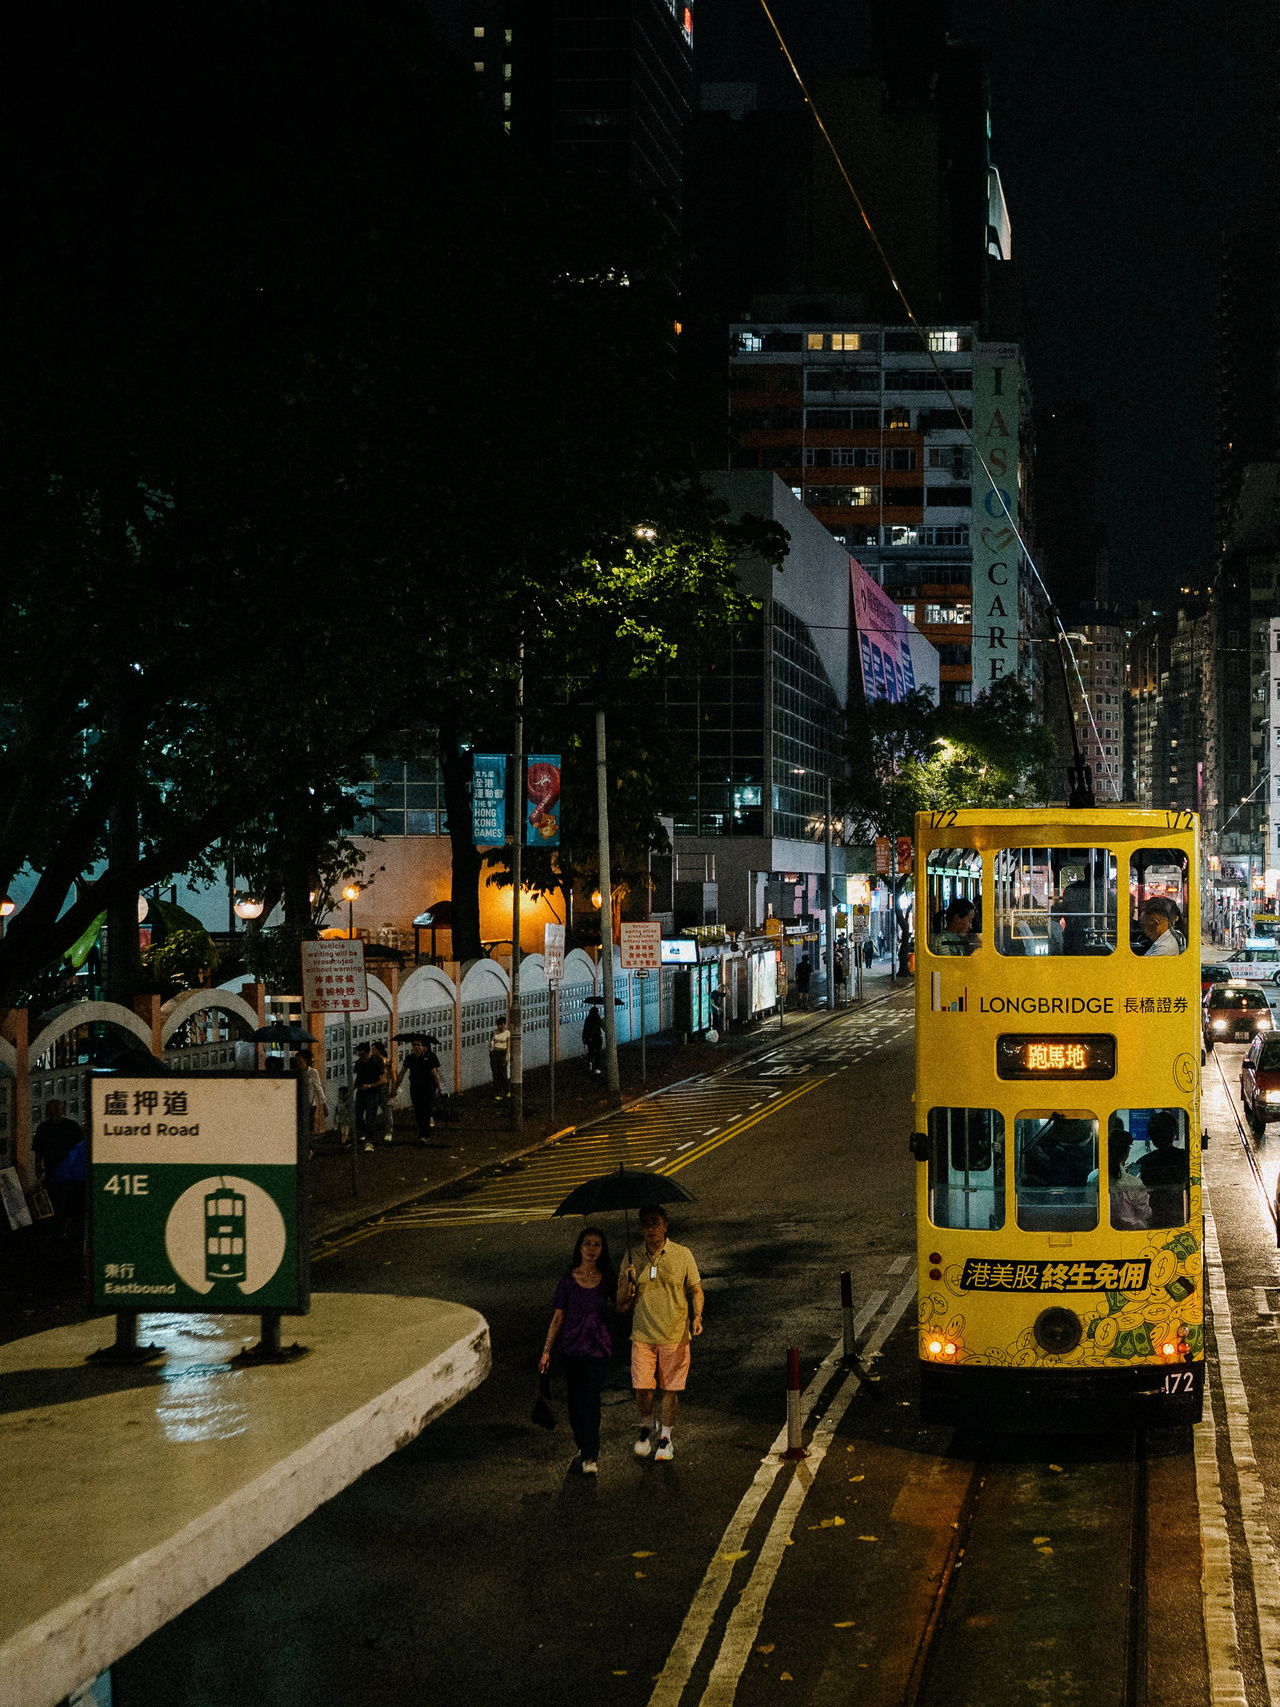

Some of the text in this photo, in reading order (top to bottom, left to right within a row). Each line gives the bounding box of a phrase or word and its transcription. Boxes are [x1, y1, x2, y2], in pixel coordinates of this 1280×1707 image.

[475, 778, 494, 788] 全港
[474, 789, 503, 799] 運動會
[474, 800, 486, 808] THE
[474, 808, 497, 818] HONG
[474, 818, 497, 828] KONG
[474, 827, 503, 838] GAMES
[308, 949, 358, 958] waiting will be
[306, 966, 333, 974] without
[979, 996, 1114, 1014] LONGBRIDGE
[1122, 995, 1189, 1015] 長橋證券
[1028, 1043, 1087, 1070] 跑馬地
[104, 1090, 189, 1116] 盧押道
[103, 1123, 200, 1137] Luard Road
[104, 1174, 149, 1196] 41E
[104, 1263, 135, 1278] 東行
[104, 1283, 176, 1294] Eastbound
[1164, 1371, 1194, 1395] 172
